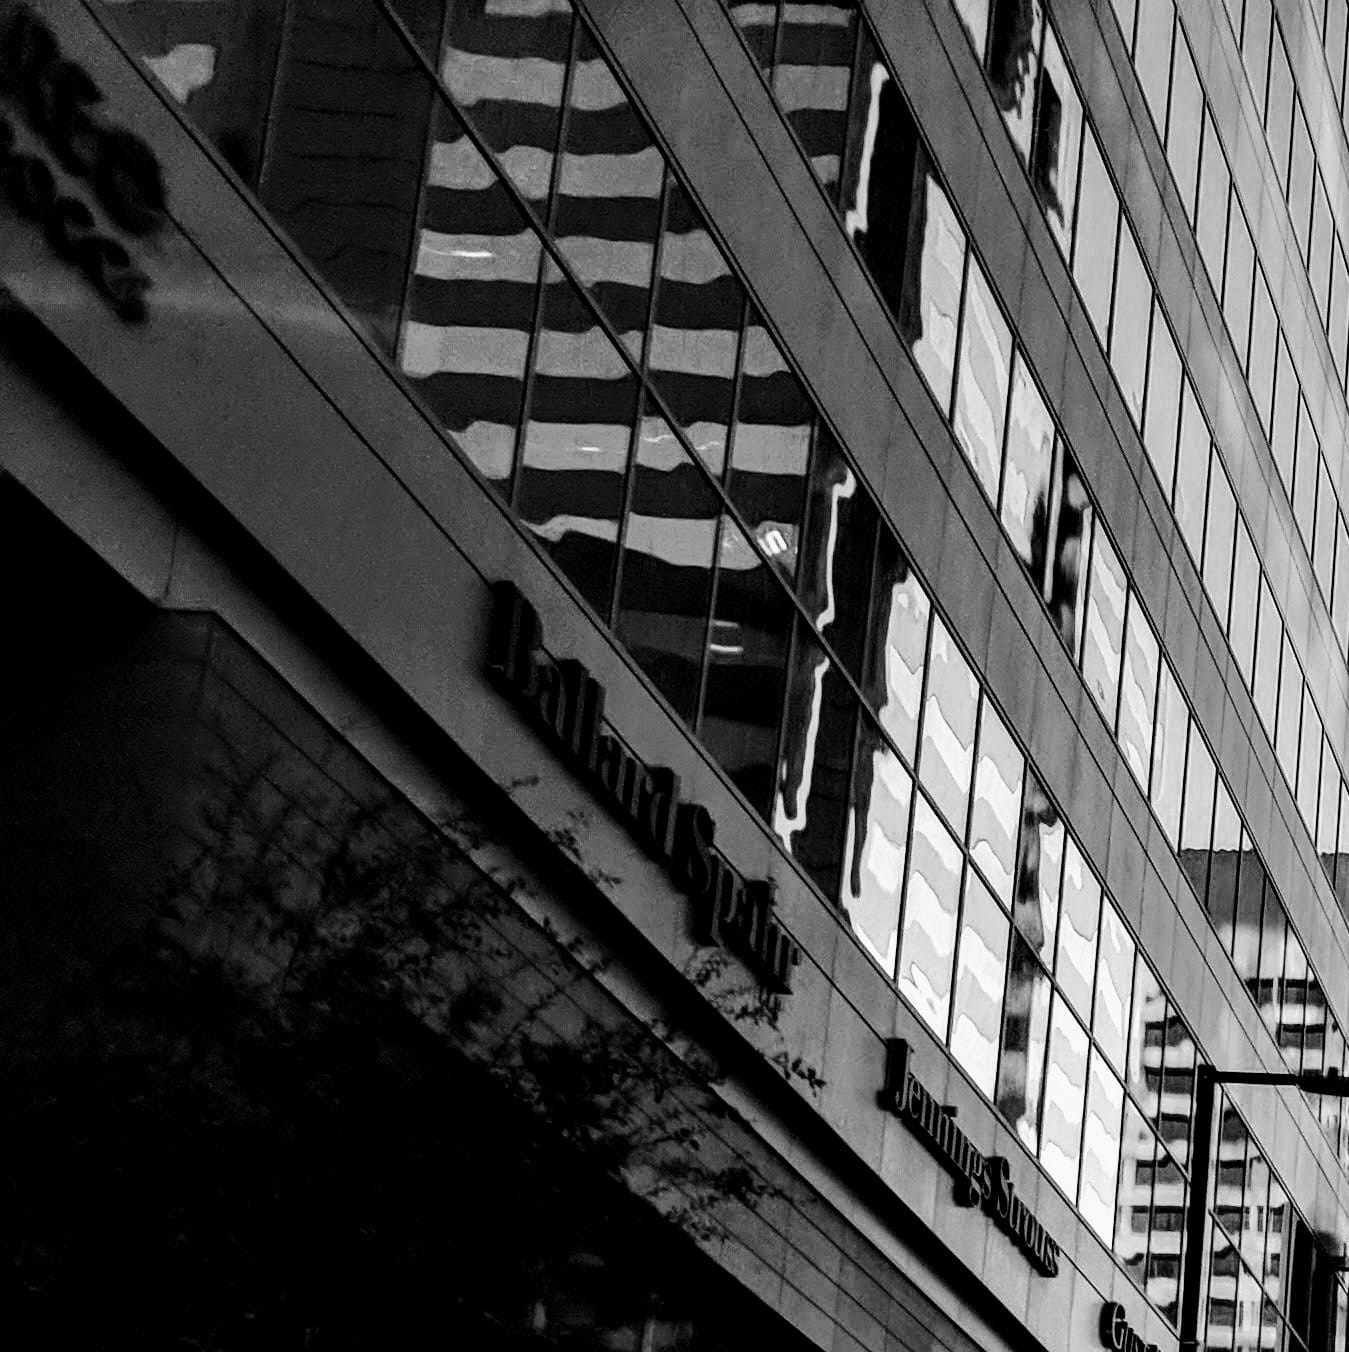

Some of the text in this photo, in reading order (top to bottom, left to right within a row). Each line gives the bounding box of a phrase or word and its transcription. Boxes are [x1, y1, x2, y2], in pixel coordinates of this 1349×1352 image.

[484, 580, 800, 995] Ballard Spahr
[878, 1038, 1060, 1278] Jennings Strouss
